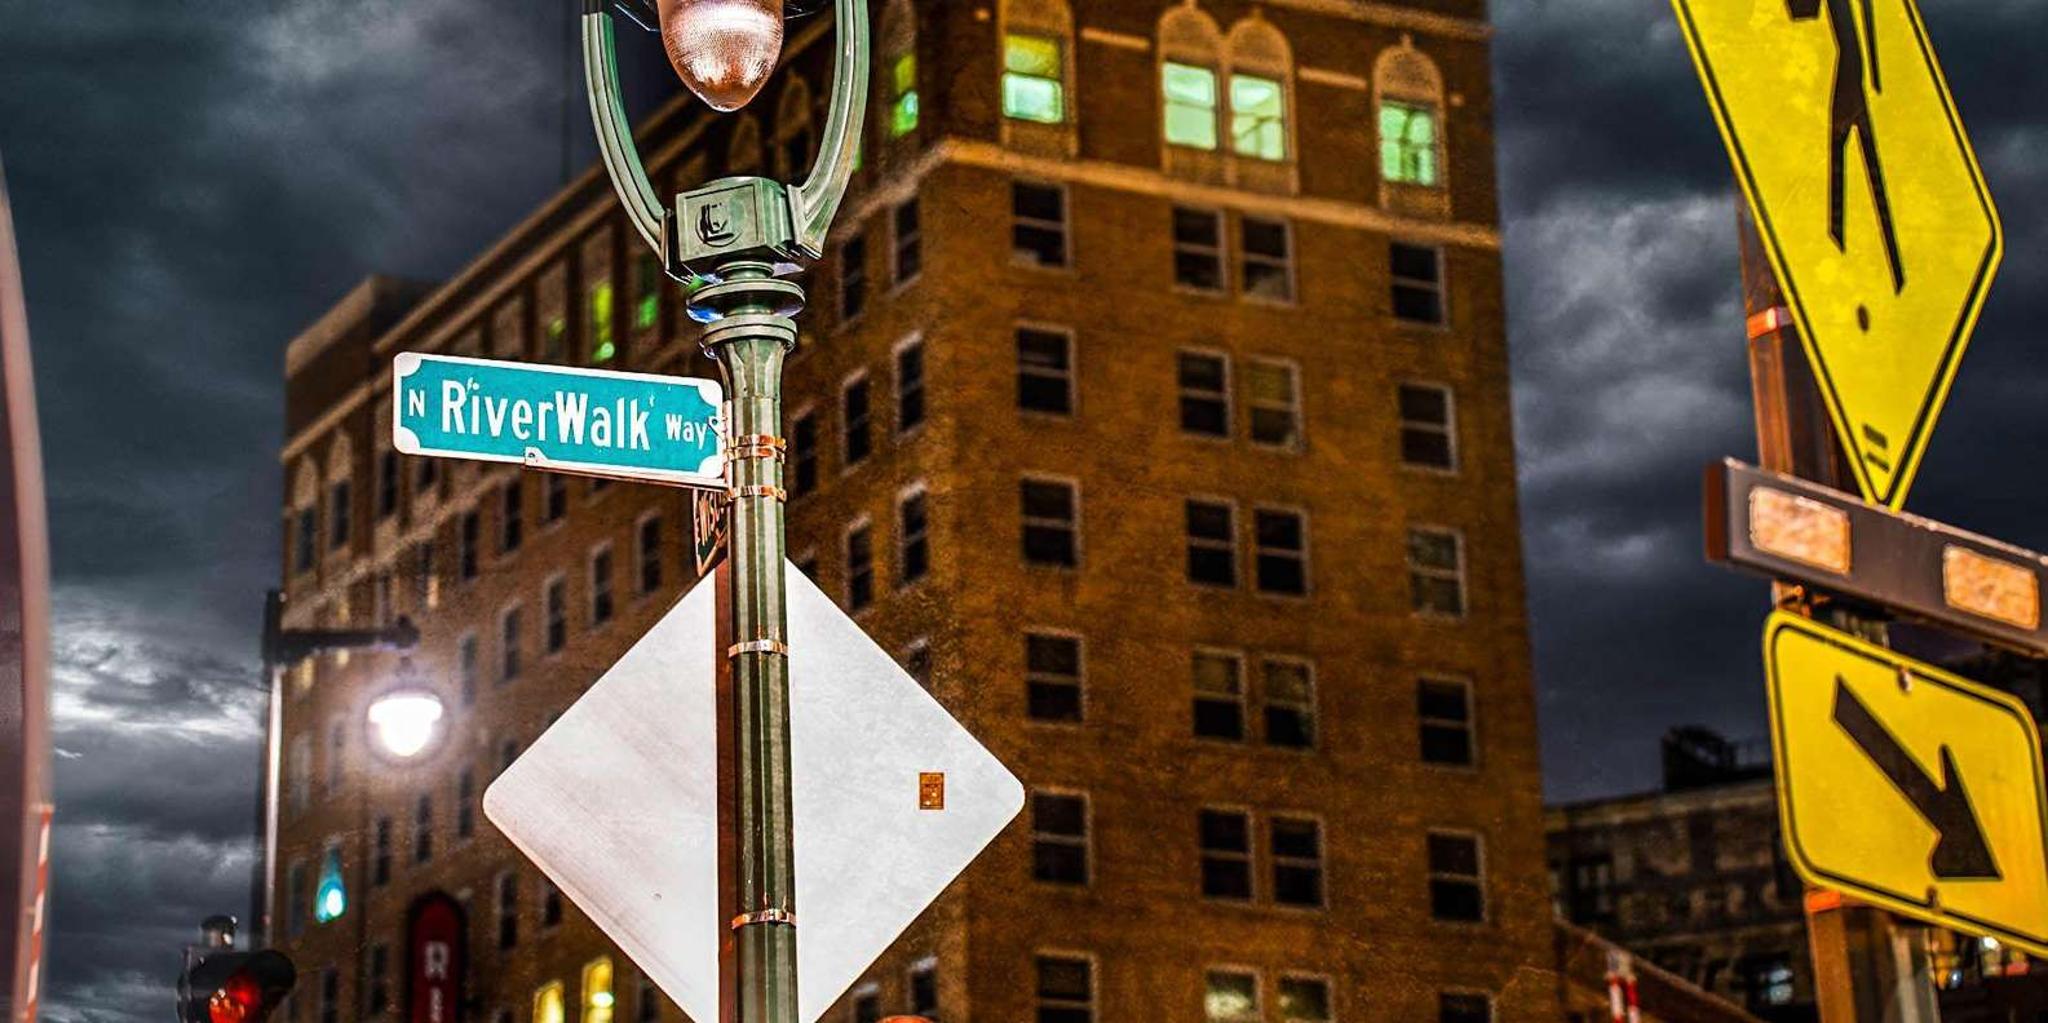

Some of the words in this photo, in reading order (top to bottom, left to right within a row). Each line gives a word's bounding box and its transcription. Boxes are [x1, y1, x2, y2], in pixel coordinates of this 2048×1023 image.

[408, 389, 425, 417] N
[442, 379, 650, 450] RiverWalk
[665, 413, 708, 450] Way
